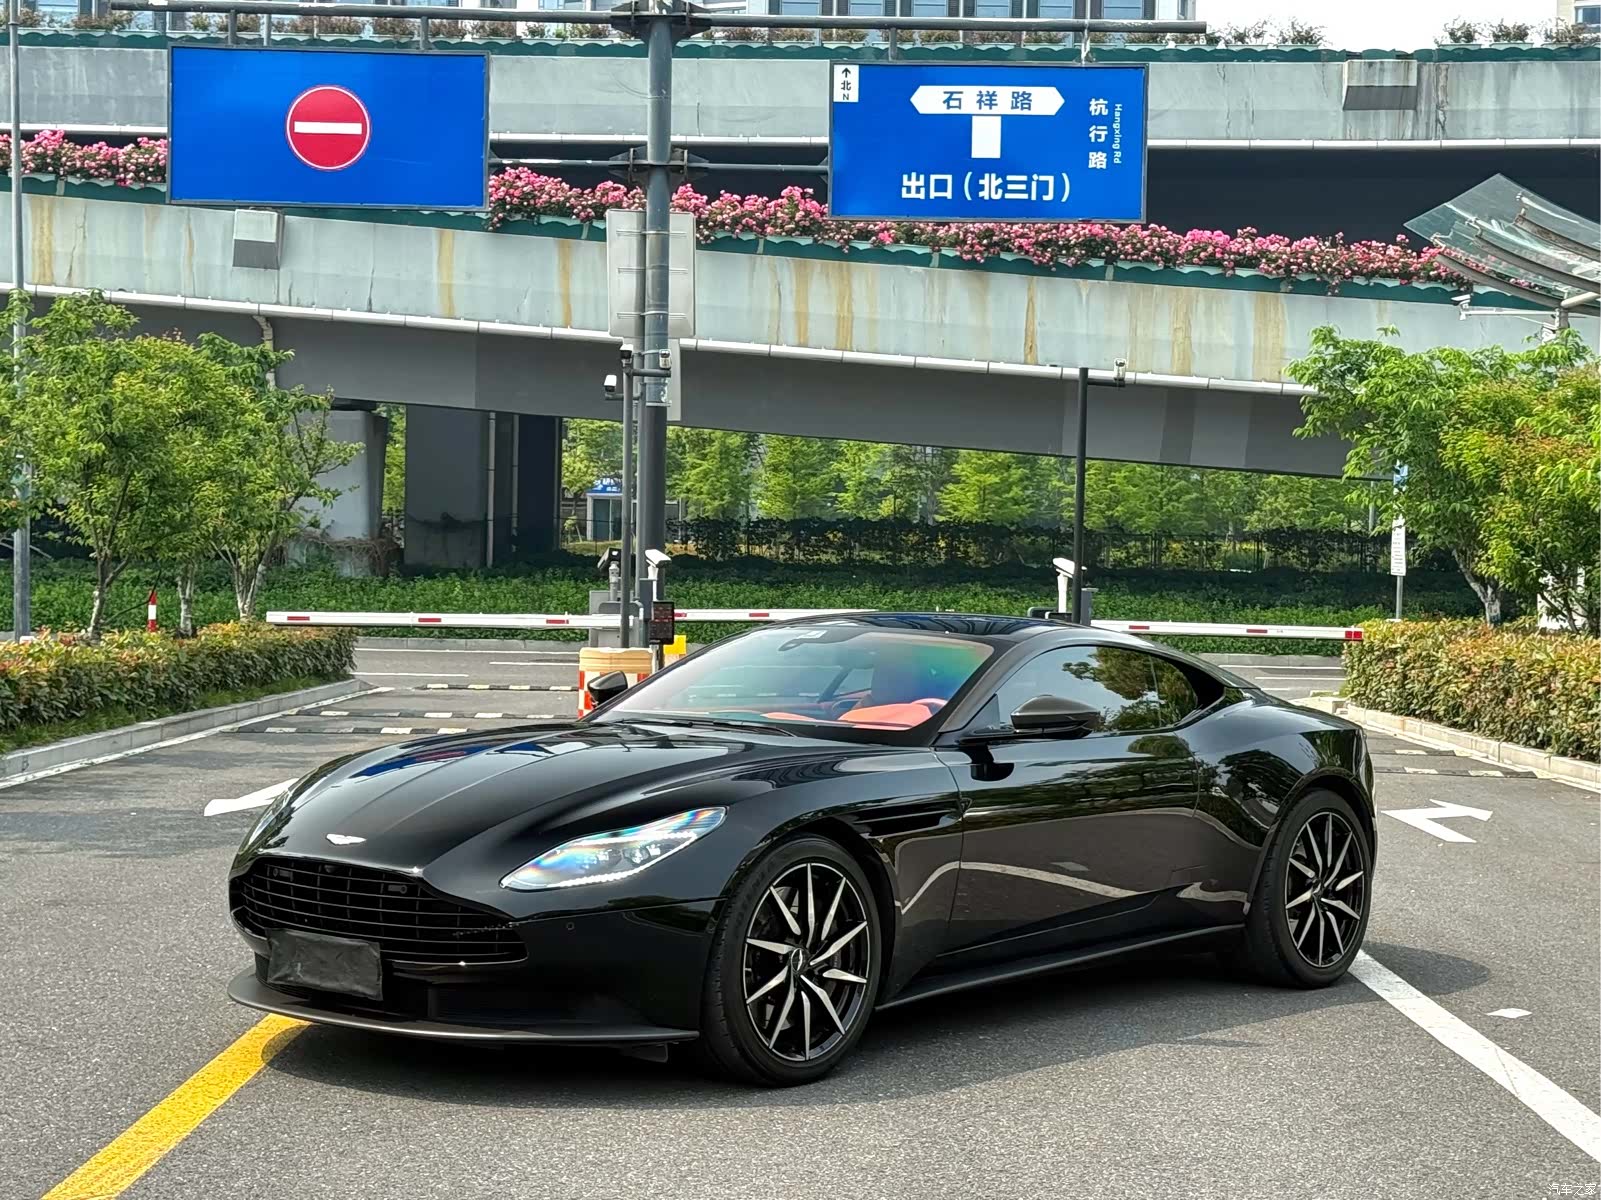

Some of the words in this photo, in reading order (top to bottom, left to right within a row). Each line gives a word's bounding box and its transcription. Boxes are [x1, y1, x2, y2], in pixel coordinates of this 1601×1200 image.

[841, 80, 851, 90] 北
[943, 91, 1033, 110] 石祥路
[1088, 98, 1108, 169] 杭行路
[1112, 103, 1123, 149] Hangxing
[1113, 151, 1122, 164] Rd
[901, 172, 1071, 202] 出口（北三门）
